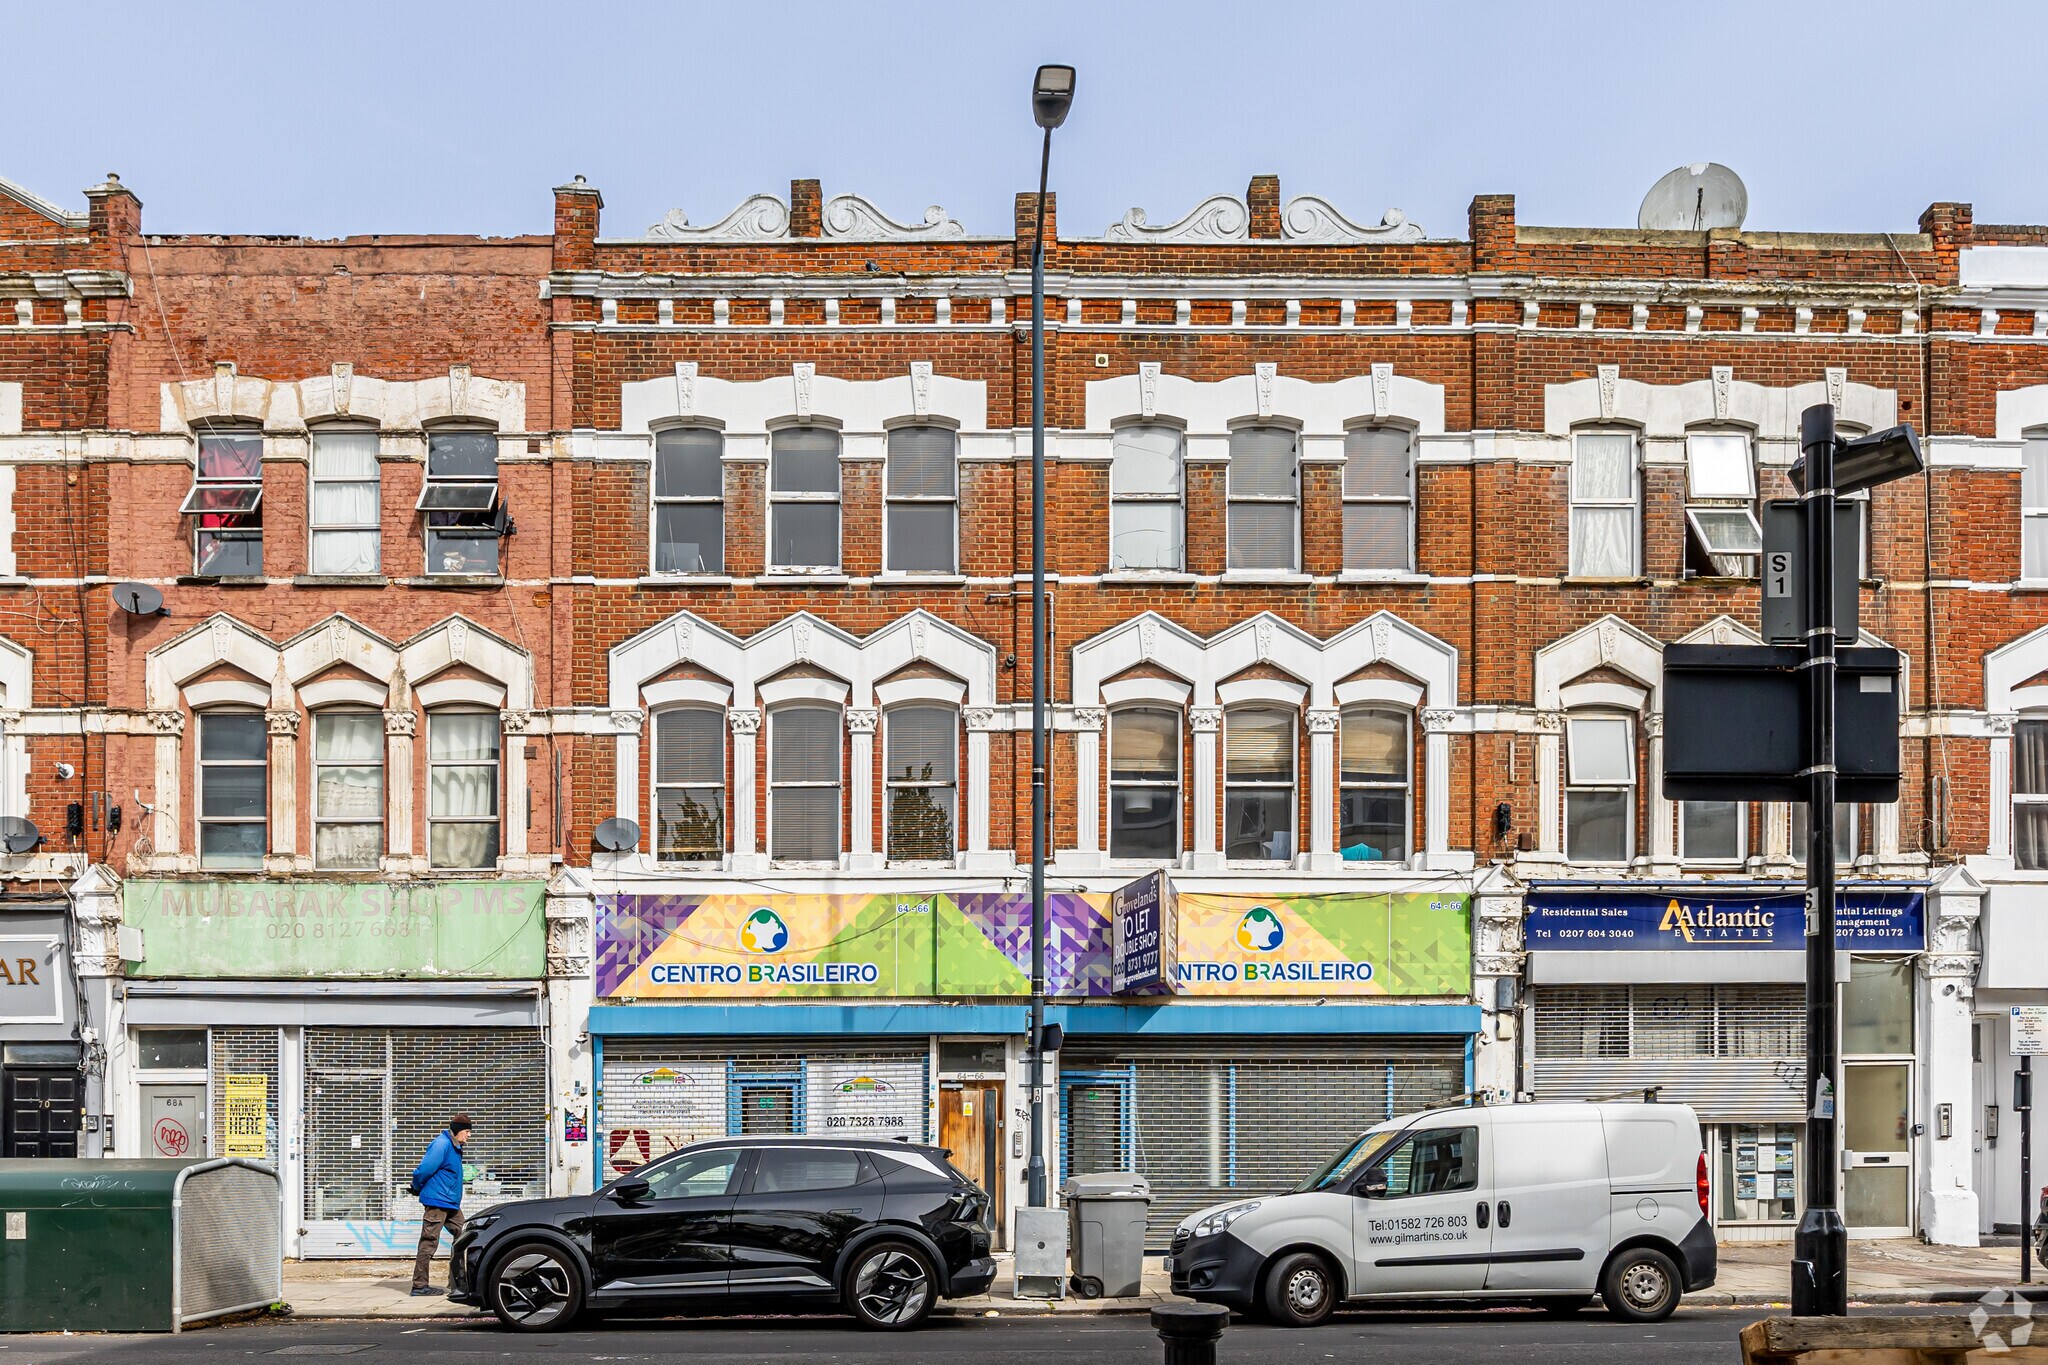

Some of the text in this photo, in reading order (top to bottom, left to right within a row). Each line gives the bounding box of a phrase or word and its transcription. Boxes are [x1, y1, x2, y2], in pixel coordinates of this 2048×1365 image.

[1771, 554, 1787, 573] S
[1775, 577, 1784, 595] 1
[162, 887, 527, 918] MUBARAK SHOP MS
[897, 904, 909, 913] 64
[917, 904, 929, 913] 66
[1430, 901, 1442, 911] 64
[1449, 901, 1461, 911] 66
[1542, 908, 1628, 916] Residential Sales
[1674, 904, 1775, 927] Atlantic
[1863, 907, 1903, 917] Lettings
[266, 922, 305, 939] 020
[1120, 908, 1150, 940] TO LET
[1836, 919, 1890, 928] anagement
[1536, 929, 1634, 938] Tel 0207 604 3040
[1674, 929, 1774, 937] ESTATES
[1857, 929, 1876, 937] 328
[1878, 929, 1904, 937] 0172
[1115, 931, 1158, 959] DOUBLE SHOP
[1114, 950, 1158, 976] 020 8731 9777
[651, 964, 878, 983] CENTRO BRASILEIRO
[1178, 962, 1373, 981] NTRO BRASILEIRO
[38, 1101, 50, 1109] 70
[166, 1098, 183, 1107] 68A
[229, 1103, 262, 1117] MONEY
[229, 1117, 262, 1135] HERE
[826, 1116, 904, 1127] 020 7328 7988
[1368, 1215, 1468, 1231] Tel:01582 726 803
[1369, 1230, 1468, 1245] www.gilmartins.co.uk
